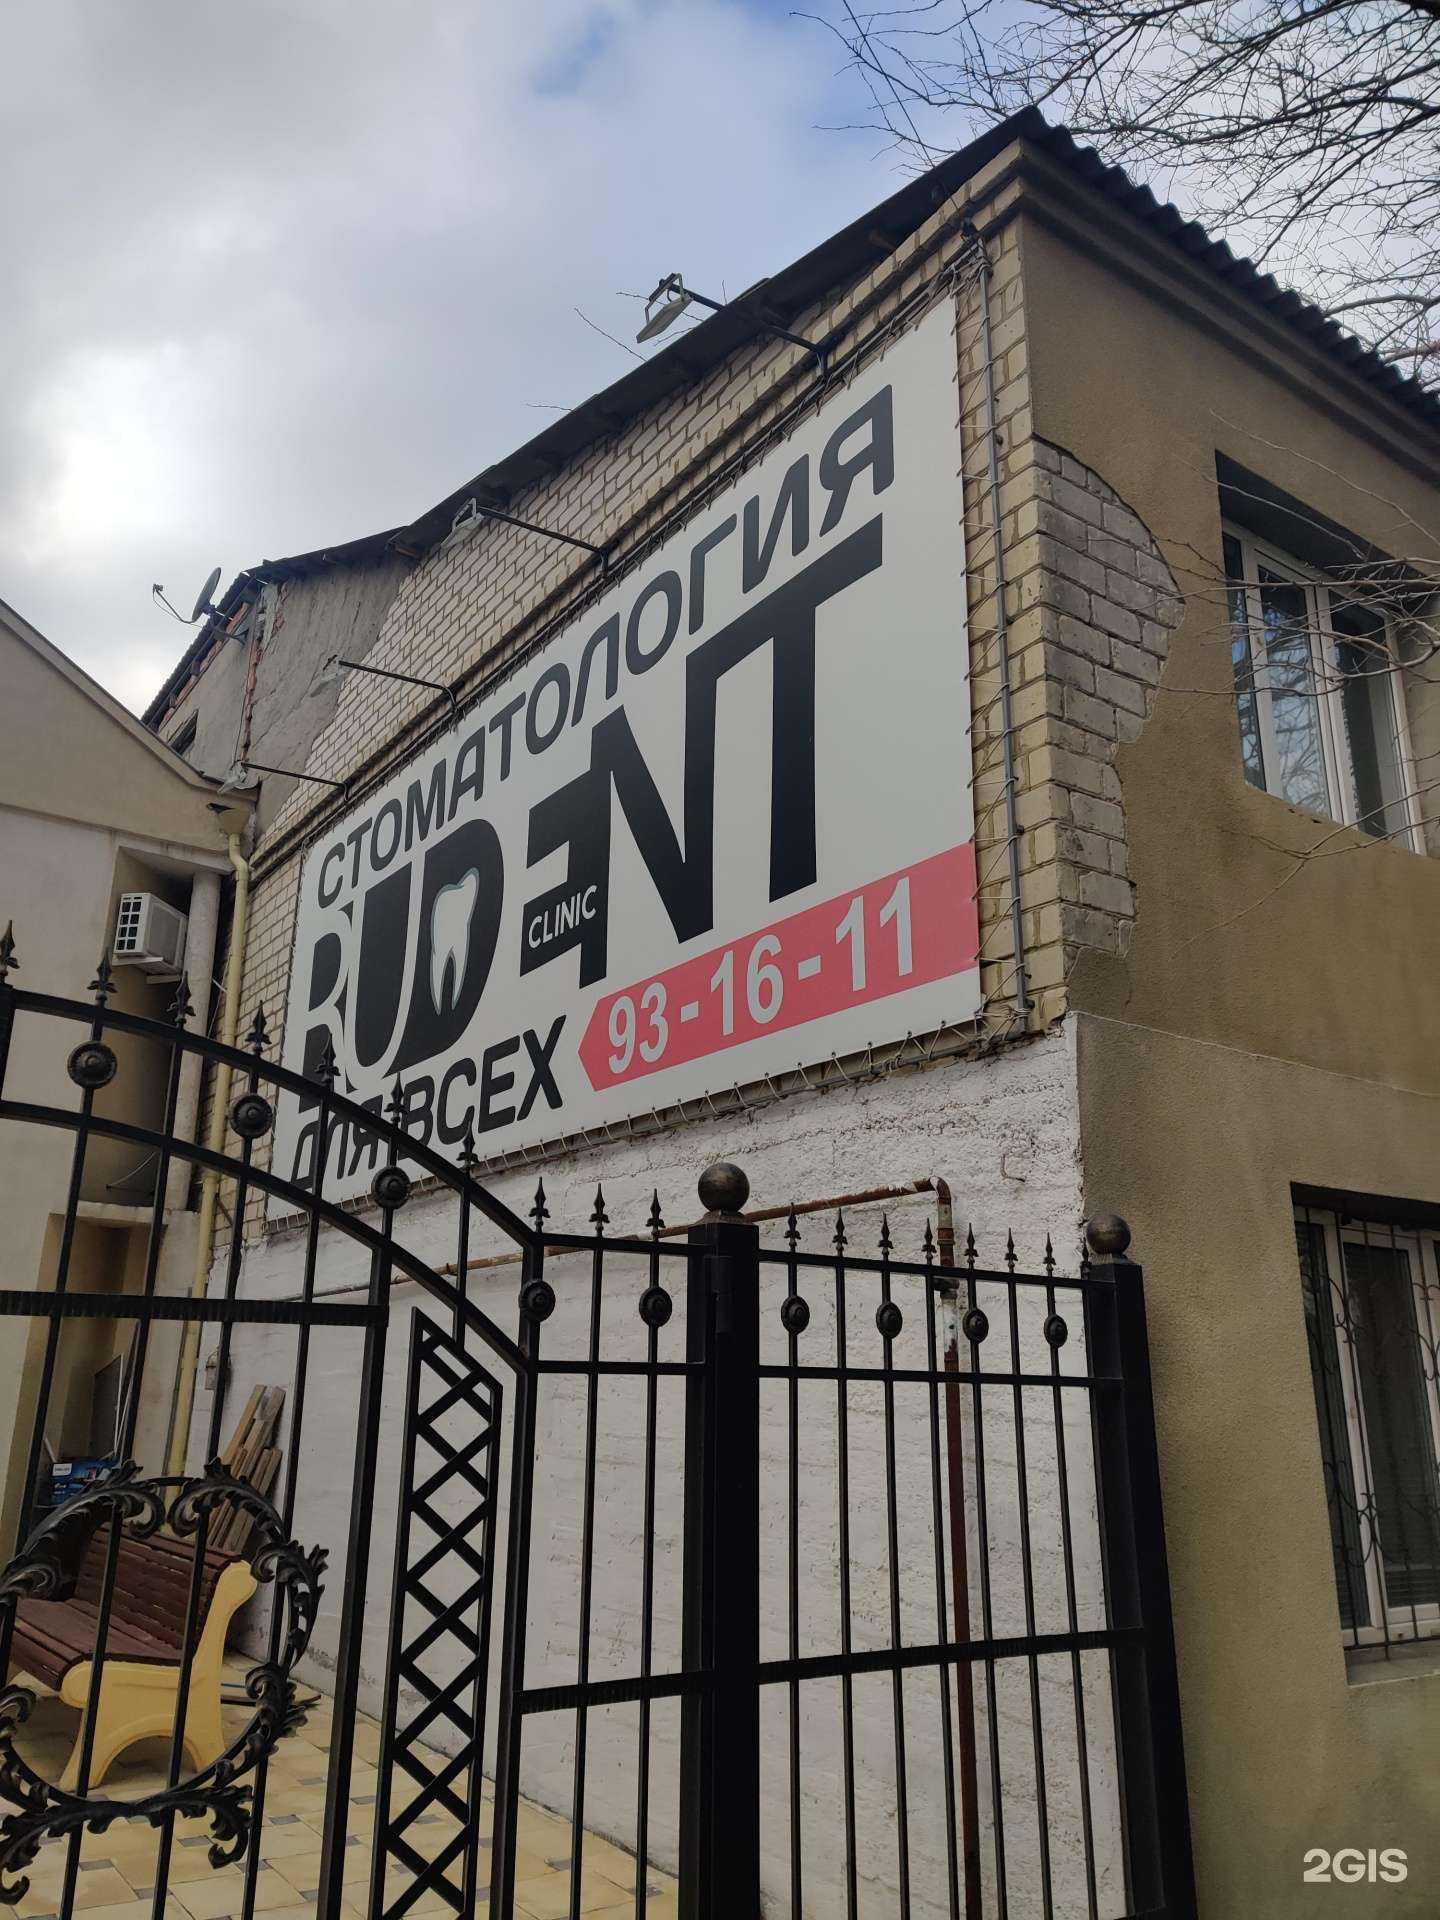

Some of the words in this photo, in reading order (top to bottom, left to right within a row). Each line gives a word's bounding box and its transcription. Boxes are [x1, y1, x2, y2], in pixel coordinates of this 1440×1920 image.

[318, 384, 895, 910] СТОМАТОЛОГИЯ
[528, 884, 598, 949] CLINIC
[607, 876, 914, 1075] 93-16-11
[398, 1014, 567, 1161] ВСЕХ
